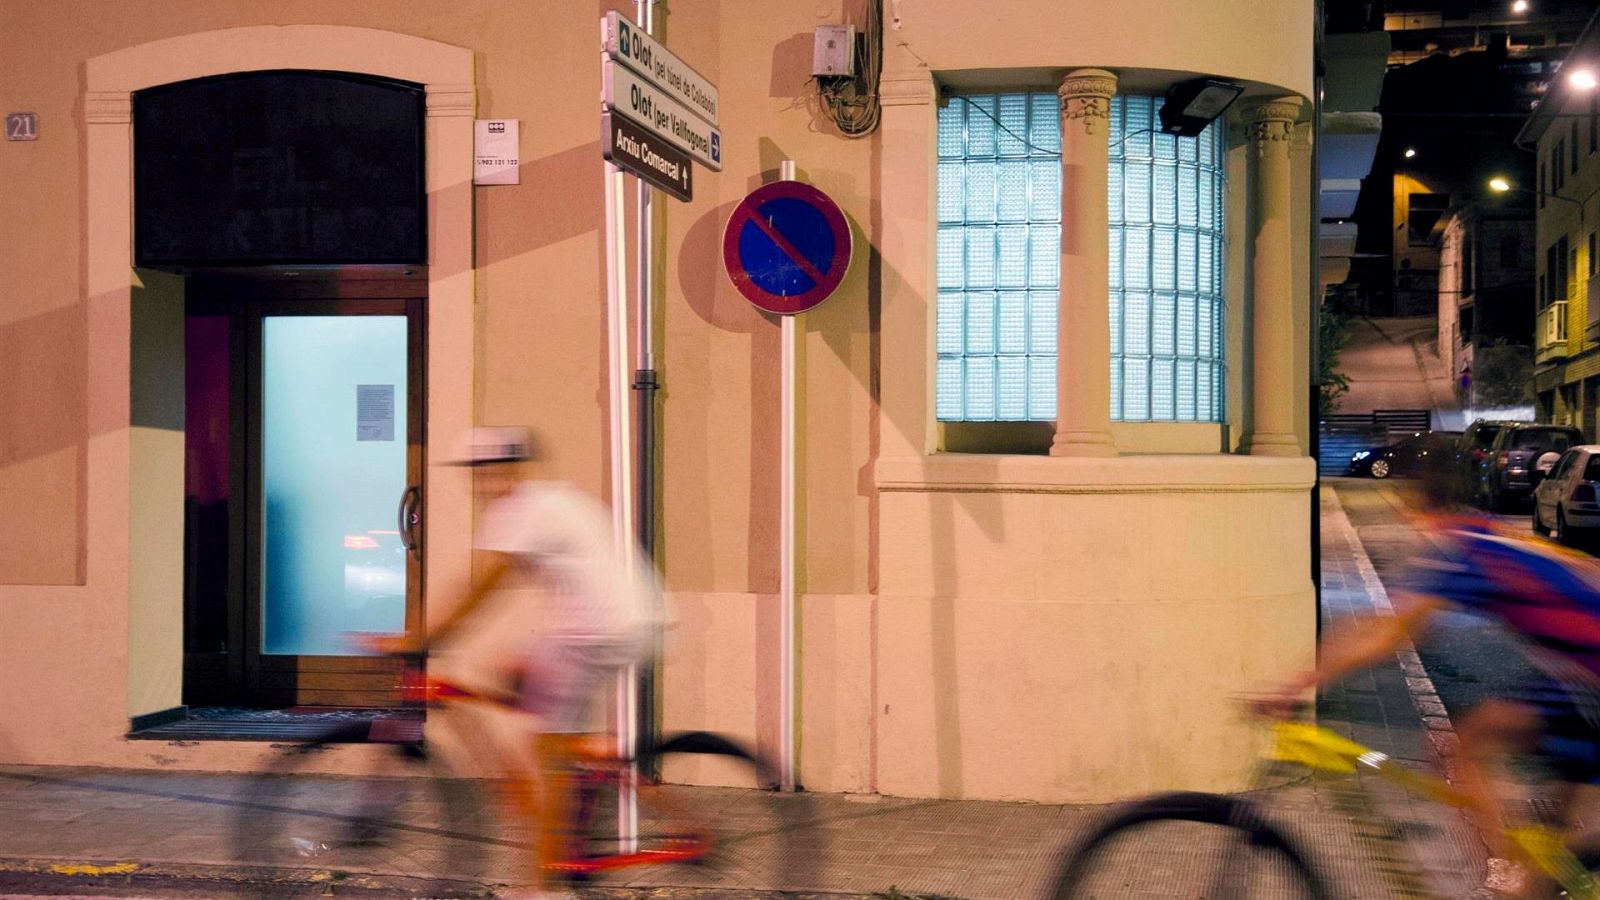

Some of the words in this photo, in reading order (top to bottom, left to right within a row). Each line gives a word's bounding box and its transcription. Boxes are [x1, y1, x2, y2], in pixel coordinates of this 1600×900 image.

[633, 32, 652, 70] Olot
[655, 54, 665, 80] (pel
[667, 65, 681, 91] túnel
[683, 78, 690, 98] de
[12, 116, 32, 137] 21
[631, 83, 652, 120] Olot
[654, 102, 669, 130] (per
[670, 112, 710, 160] Vallfogona)
[616, 128, 640, 159] Arxiu
[641, 142, 679, 181] Comarcal
